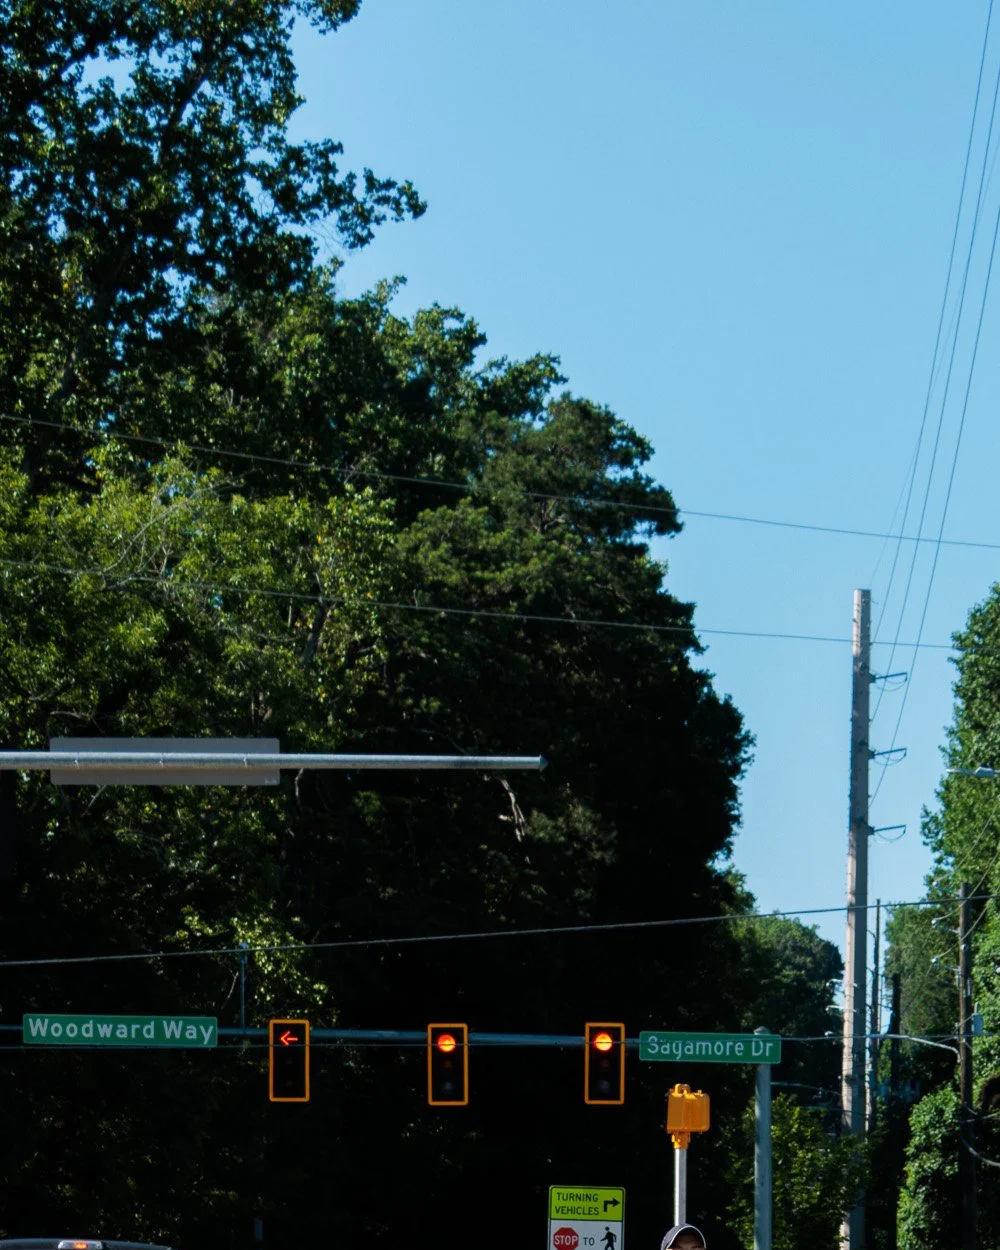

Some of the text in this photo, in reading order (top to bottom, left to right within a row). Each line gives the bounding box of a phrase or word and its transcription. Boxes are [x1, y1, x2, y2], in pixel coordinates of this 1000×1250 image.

[28, 1018, 214, 1045] Woodward Way
[647, 1035, 774, 1060] Sagamore Dr
[556, 1192, 599, 1202] TURNING
[554, 1206, 600, 1216] VEHICLES
[554, 1234, 595, 1246] STOP TO
